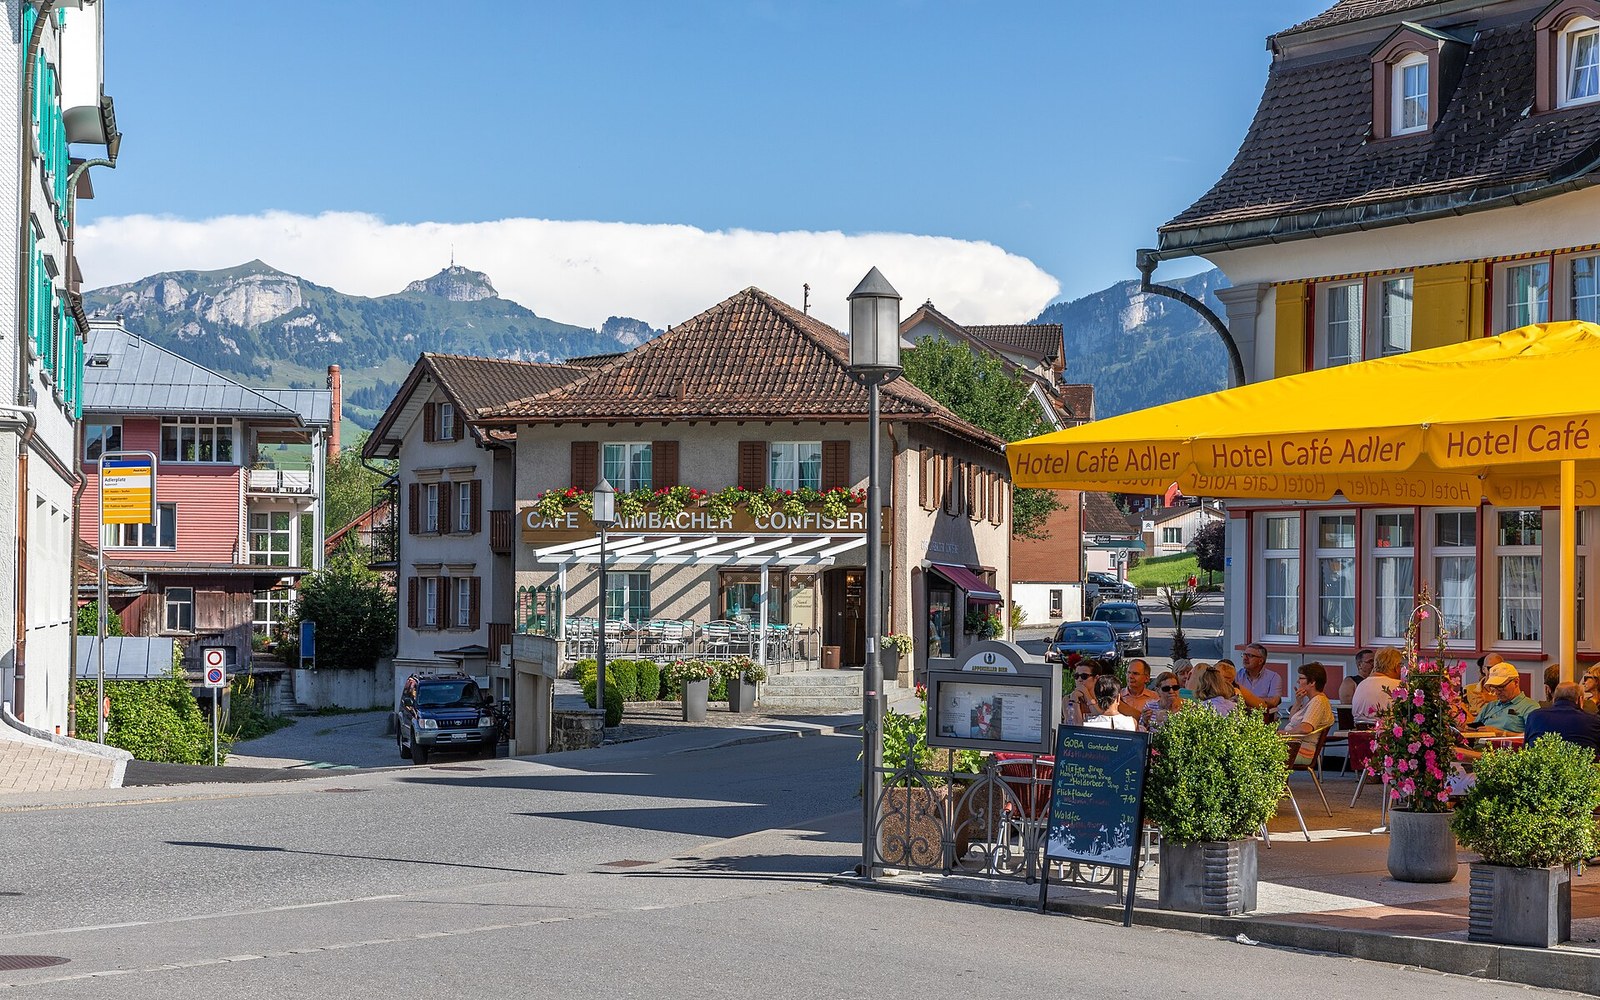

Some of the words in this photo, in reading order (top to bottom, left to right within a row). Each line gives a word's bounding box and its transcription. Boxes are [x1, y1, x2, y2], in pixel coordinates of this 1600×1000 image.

[1212, 440, 1273, 468] Hotel
[1281, 438, 1333, 466] Café
[1339, 436, 1406, 464] Adler
[1447, 425, 1518, 459] Hotel
[1528, 419, 1590, 452] Café
[1016, 450, 1070, 475] Hotel
[1076, 448, 1120, 473] Café
[1124, 445, 1180, 472] Adler
[608, 512, 733, 529] AIMBACHER
[1064, 737, 1084, 750] GOBA
